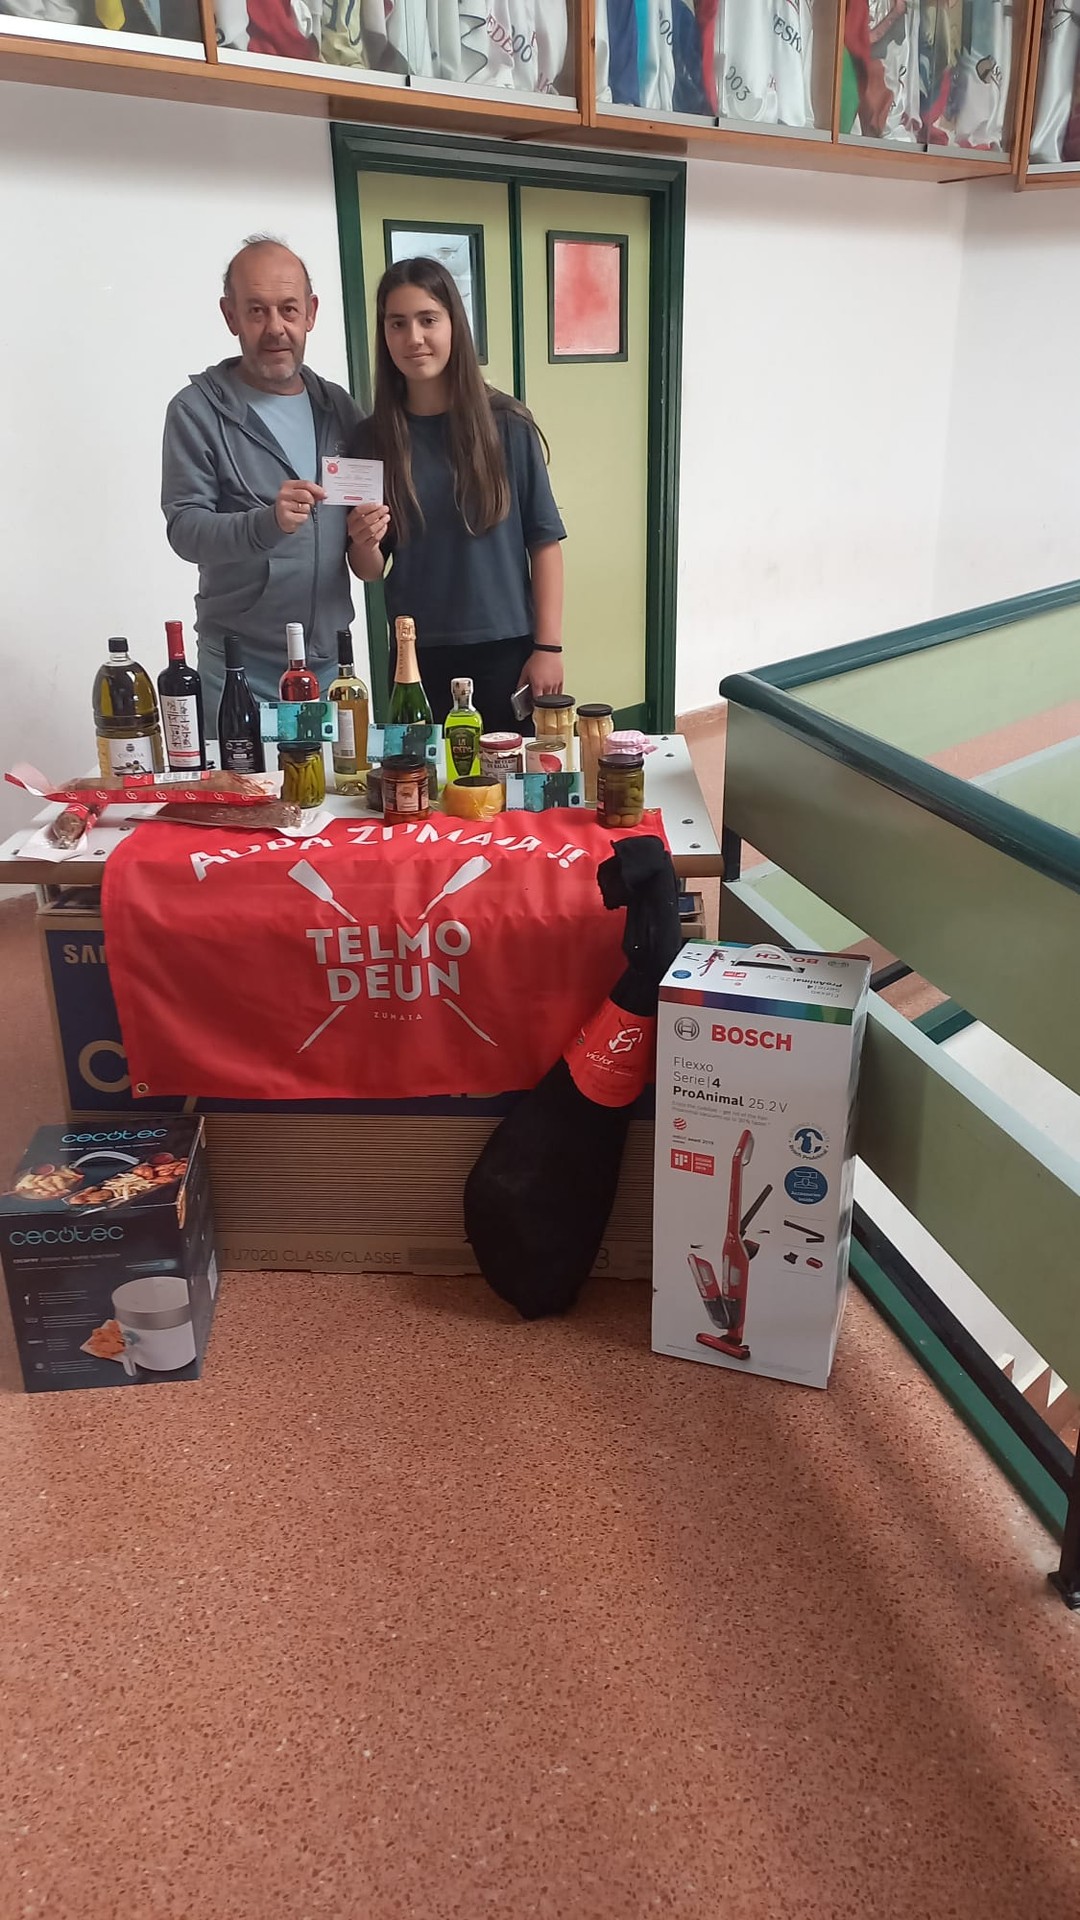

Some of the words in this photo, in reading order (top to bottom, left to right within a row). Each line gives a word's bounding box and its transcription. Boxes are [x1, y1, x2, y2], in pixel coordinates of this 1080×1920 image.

[305, 920, 471, 964] TELMO
[755, 952, 819, 965] BOCH
[326, 960, 460, 1002] DEUN
[711, 1024, 792, 1051] BOSCH
[673, 1056, 714, 1073] Flexxo
[673, 1085, 744, 1107] ProAnimal
[9, 1224, 124, 1246] cecotec
[223, 1248, 278, 1263] TU7020
